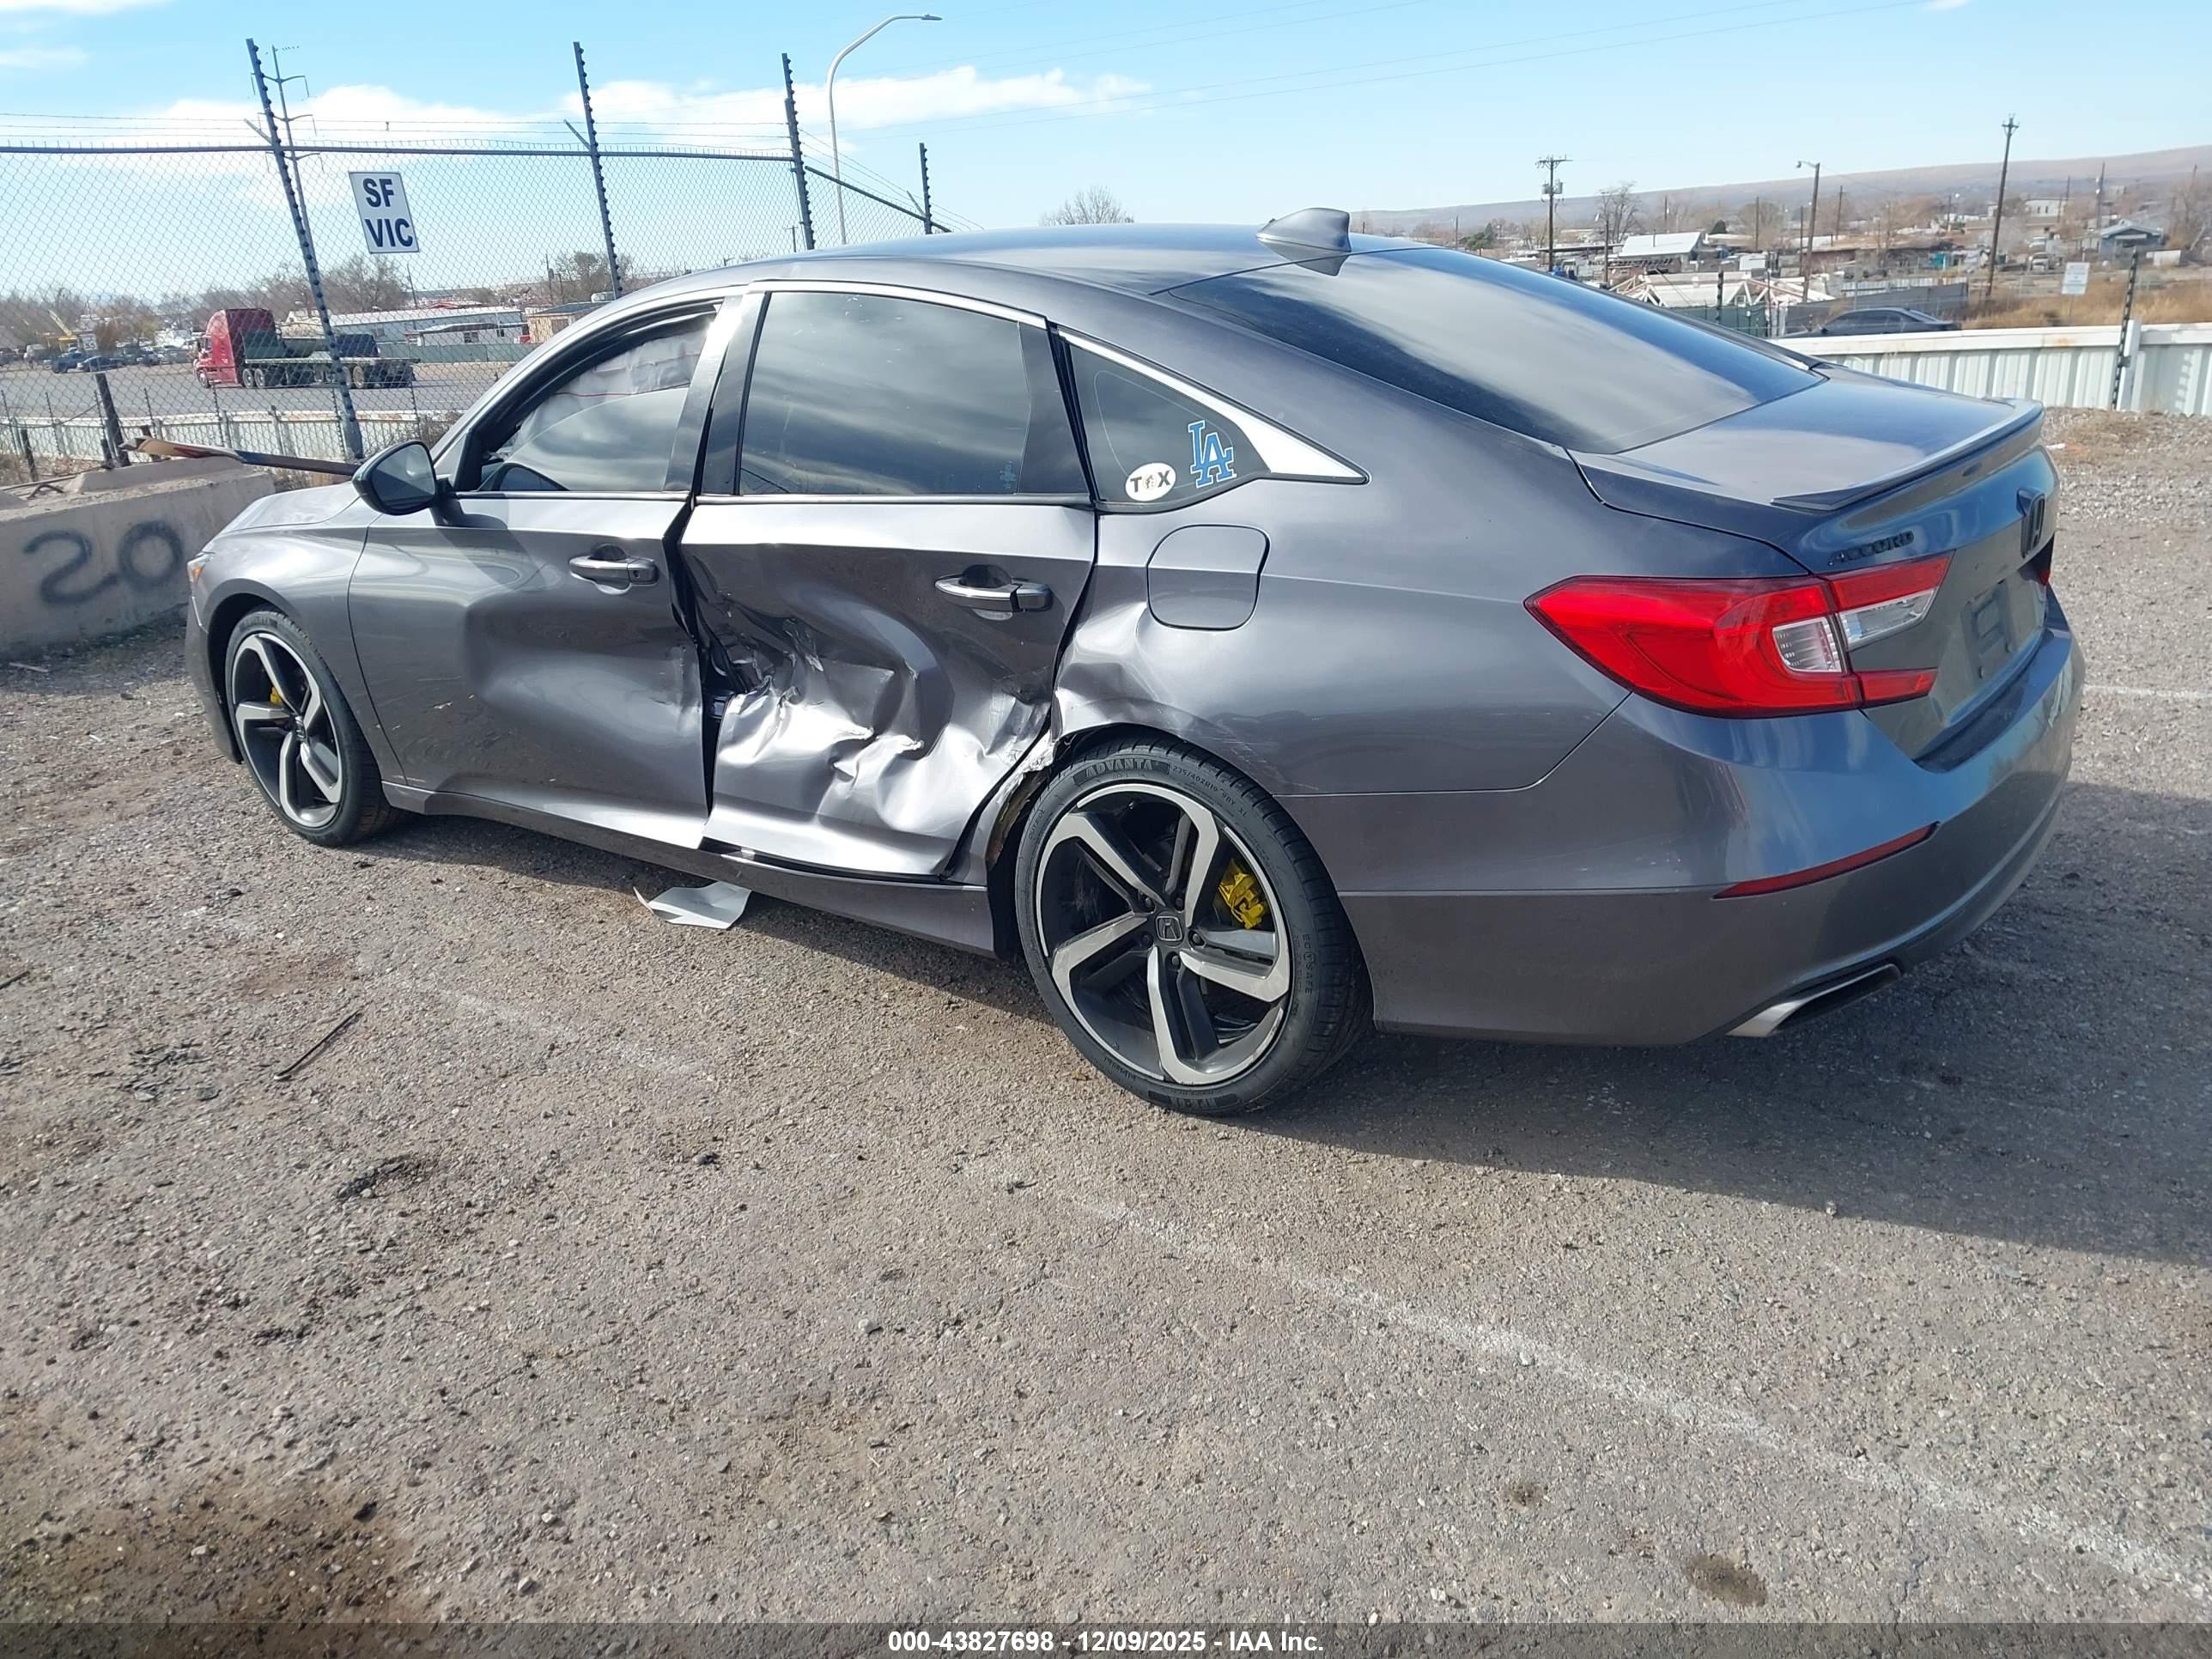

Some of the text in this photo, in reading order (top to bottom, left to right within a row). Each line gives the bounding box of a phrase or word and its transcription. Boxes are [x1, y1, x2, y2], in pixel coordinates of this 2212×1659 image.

[362, 178, 394, 208] SF
[364, 218, 413, 247] VIC
[1188, 420, 1237, 489] LA
[22, 520, 185, 605] 20
[1085, 759, 1152, 777] ADVANTA
